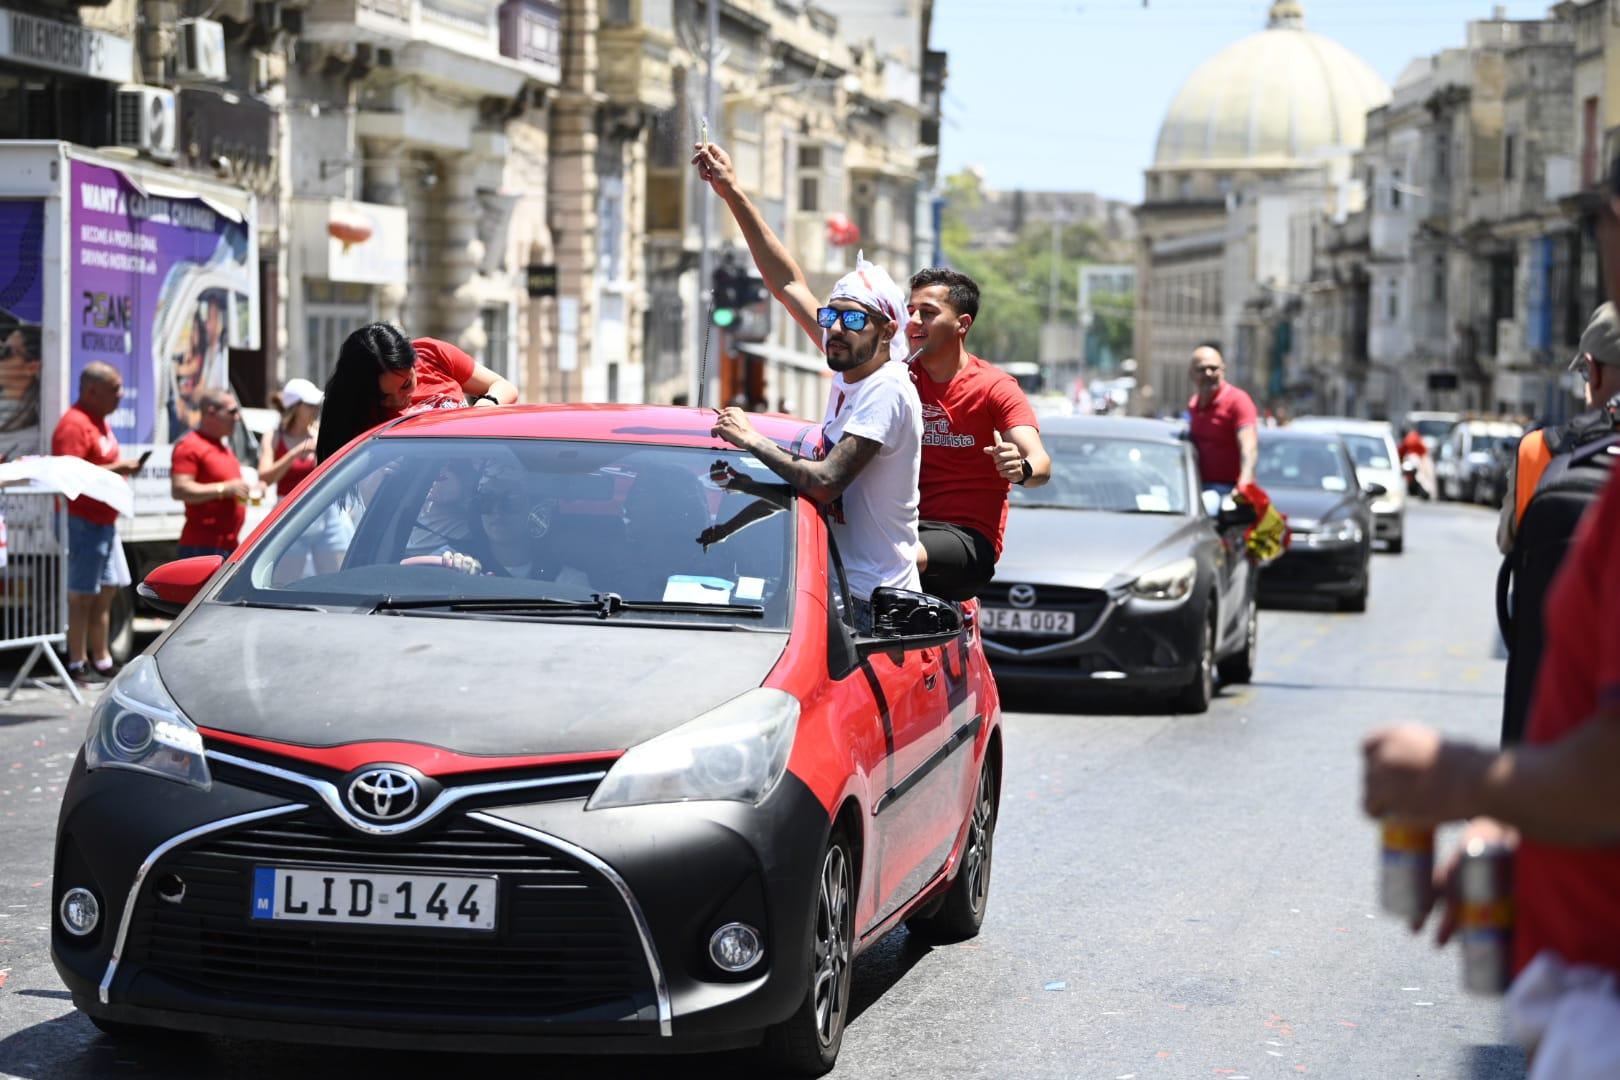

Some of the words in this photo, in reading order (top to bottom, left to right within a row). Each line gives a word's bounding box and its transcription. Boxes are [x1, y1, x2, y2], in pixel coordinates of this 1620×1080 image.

[80, 182, 118, 214] WANT
[117, 191, 129, 216] A
[983, 611, 1021, 629] JEA
[1030, 612, 1068, 631] 002
[258, 898, 269, 910] M
[284, 875, 374, 917] LID
[394, 881, 481, 923] 144
